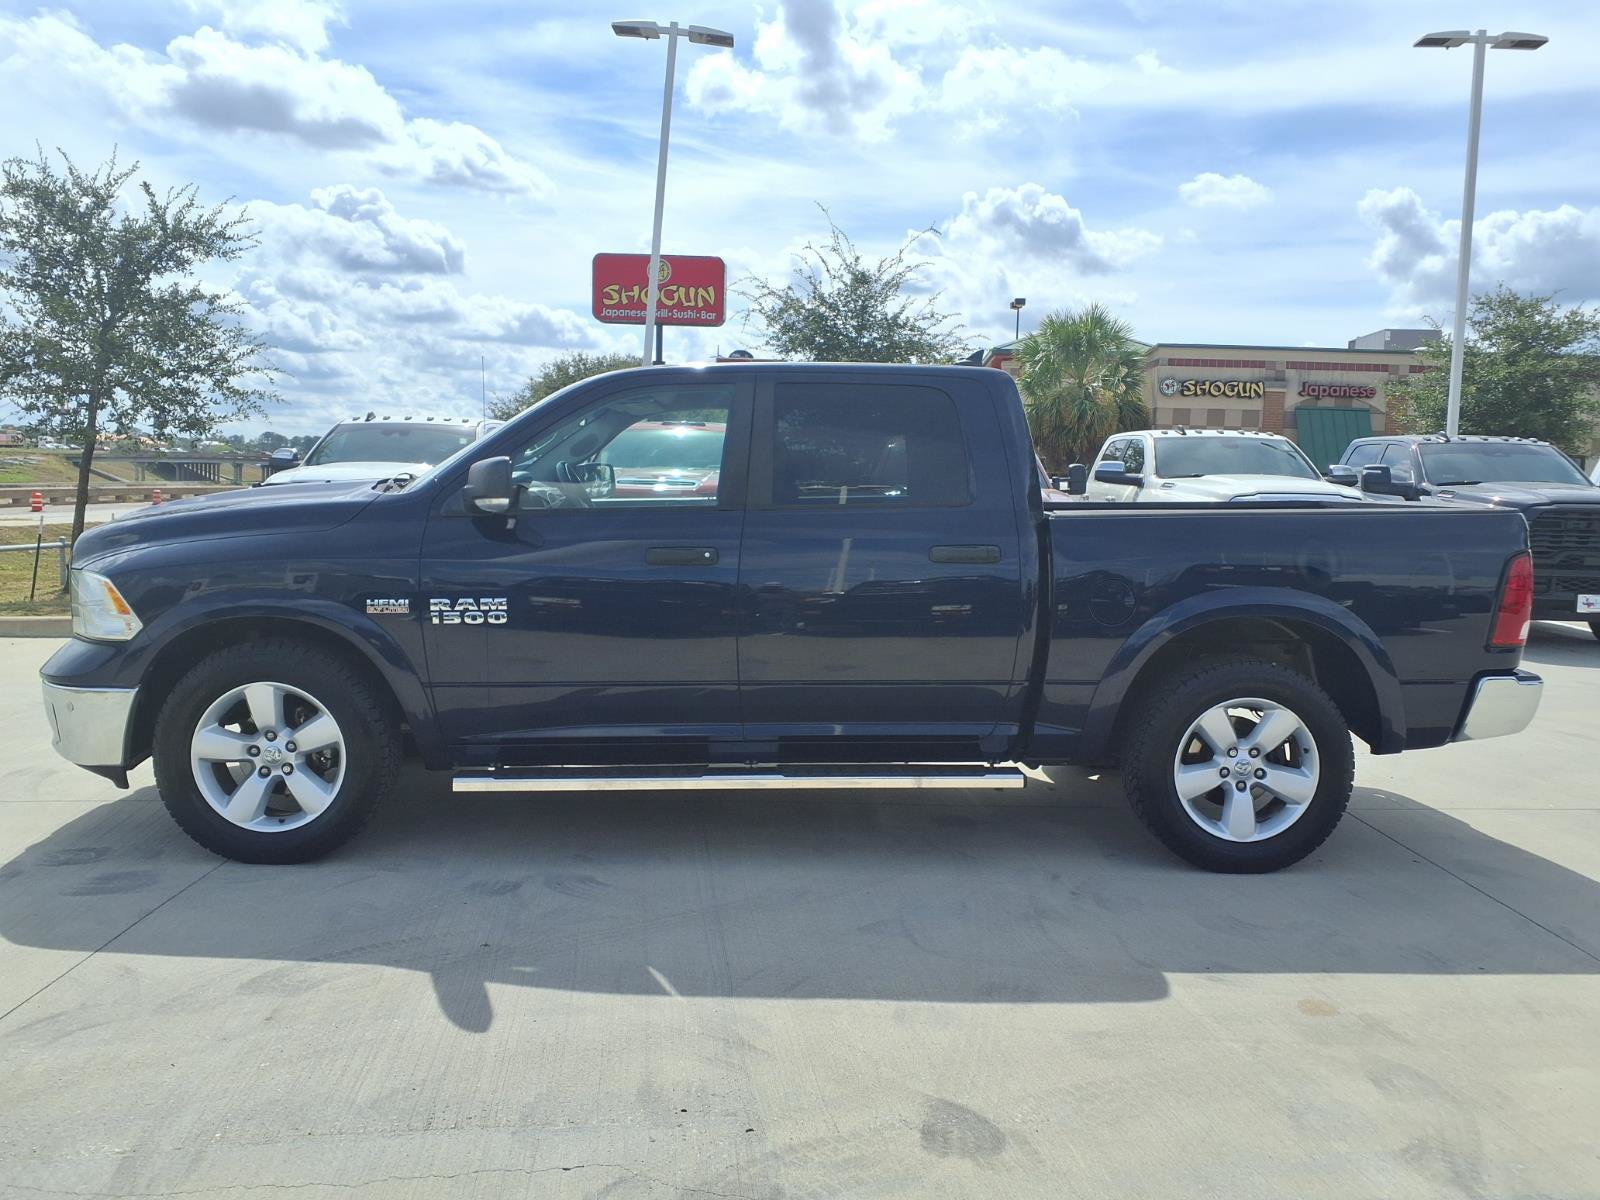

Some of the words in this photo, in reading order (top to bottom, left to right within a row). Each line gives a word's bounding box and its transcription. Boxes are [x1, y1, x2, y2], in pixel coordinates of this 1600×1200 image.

[601, 307, 647, 318] Japanese
[672, 309, 697, 320] Sushi
[701, 312, 717, 320] Bar
[1182, 379, 1264, 399] SHOGUN
[1299, 381, 1377, 399] Japanese
[429, 597, 508, 611] RAM
[430, 611, 508, 625] 1500
